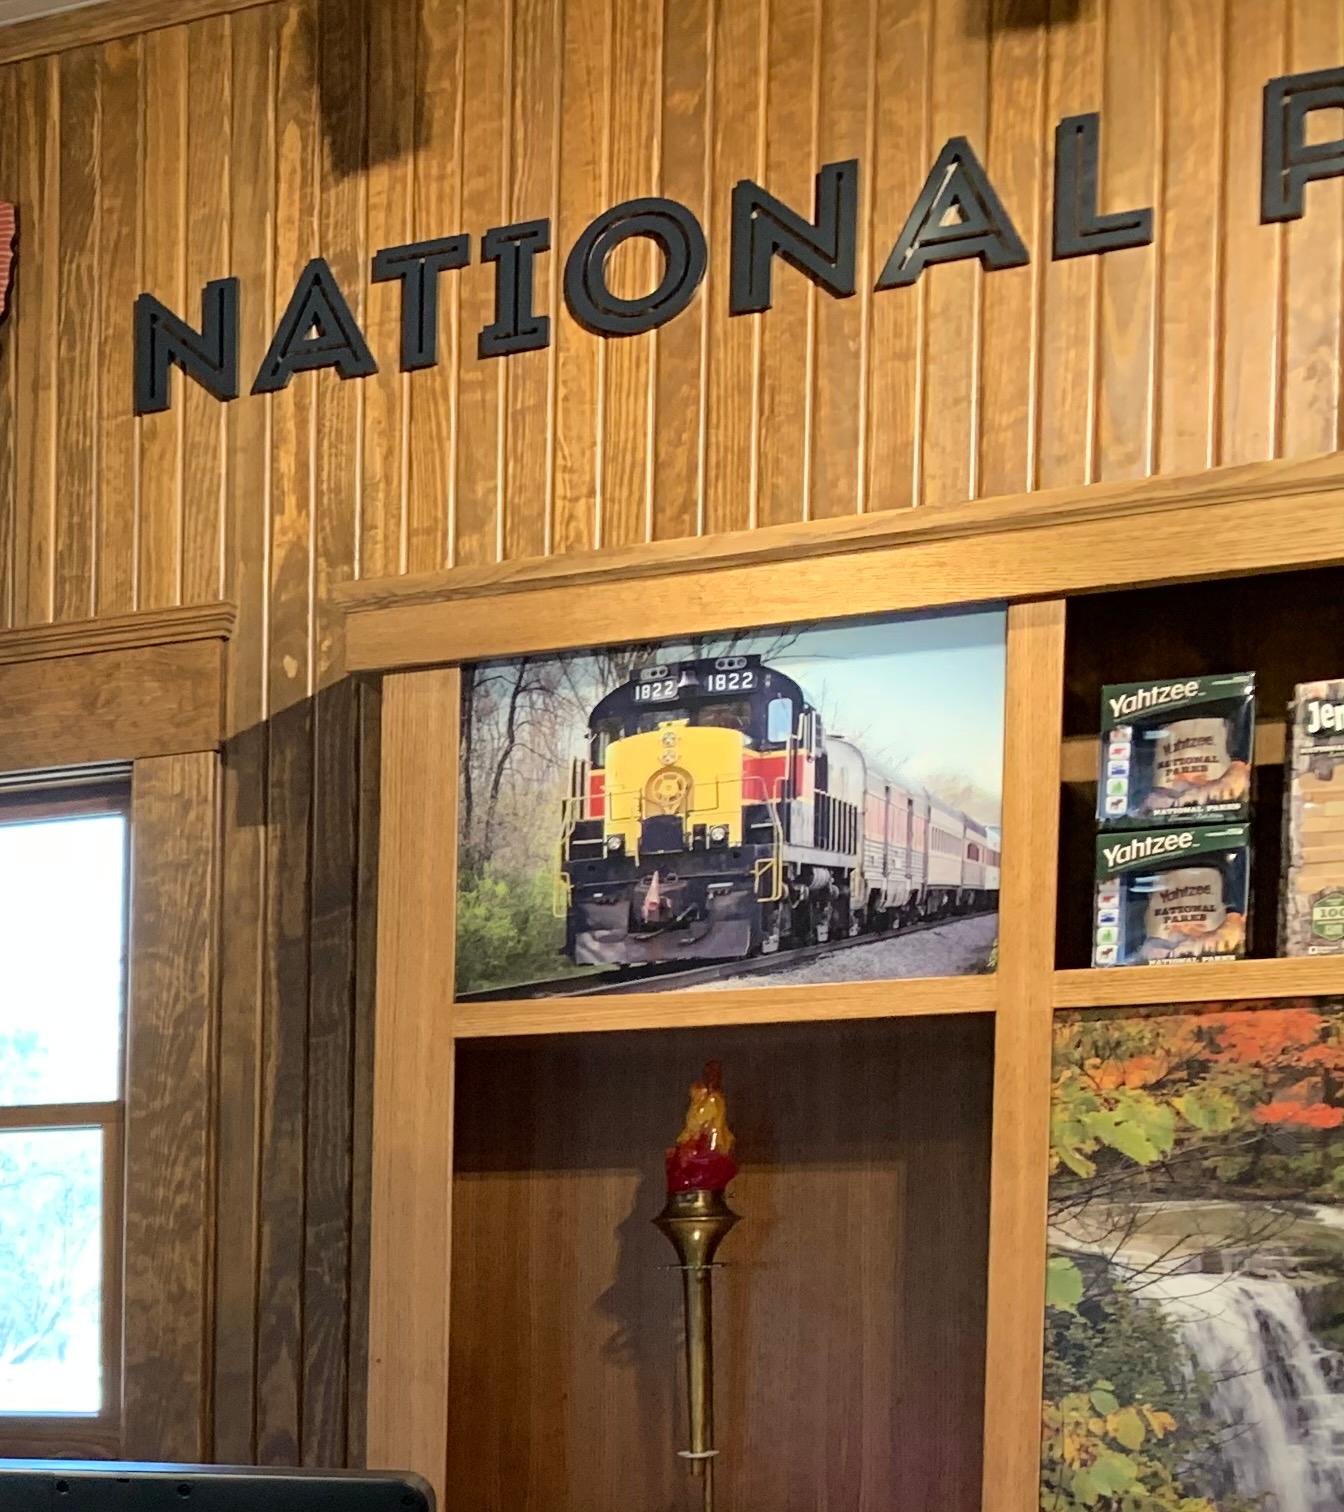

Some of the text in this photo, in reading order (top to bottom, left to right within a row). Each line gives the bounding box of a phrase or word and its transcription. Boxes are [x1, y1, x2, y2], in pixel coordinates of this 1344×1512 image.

[133, 111, 1154, 416] NATIONAL
[635, 681, 674, 700] 1822
[708, 672, 753, 691] 1822
[1109, 681, 1200, 718] Yahtzee
[1153, 803, 1242, 816] NATIONAL PARKS
[1103, 832, 1194, 868] Yahtzee
[1154, 904, 1217, 917] NATIONAL
